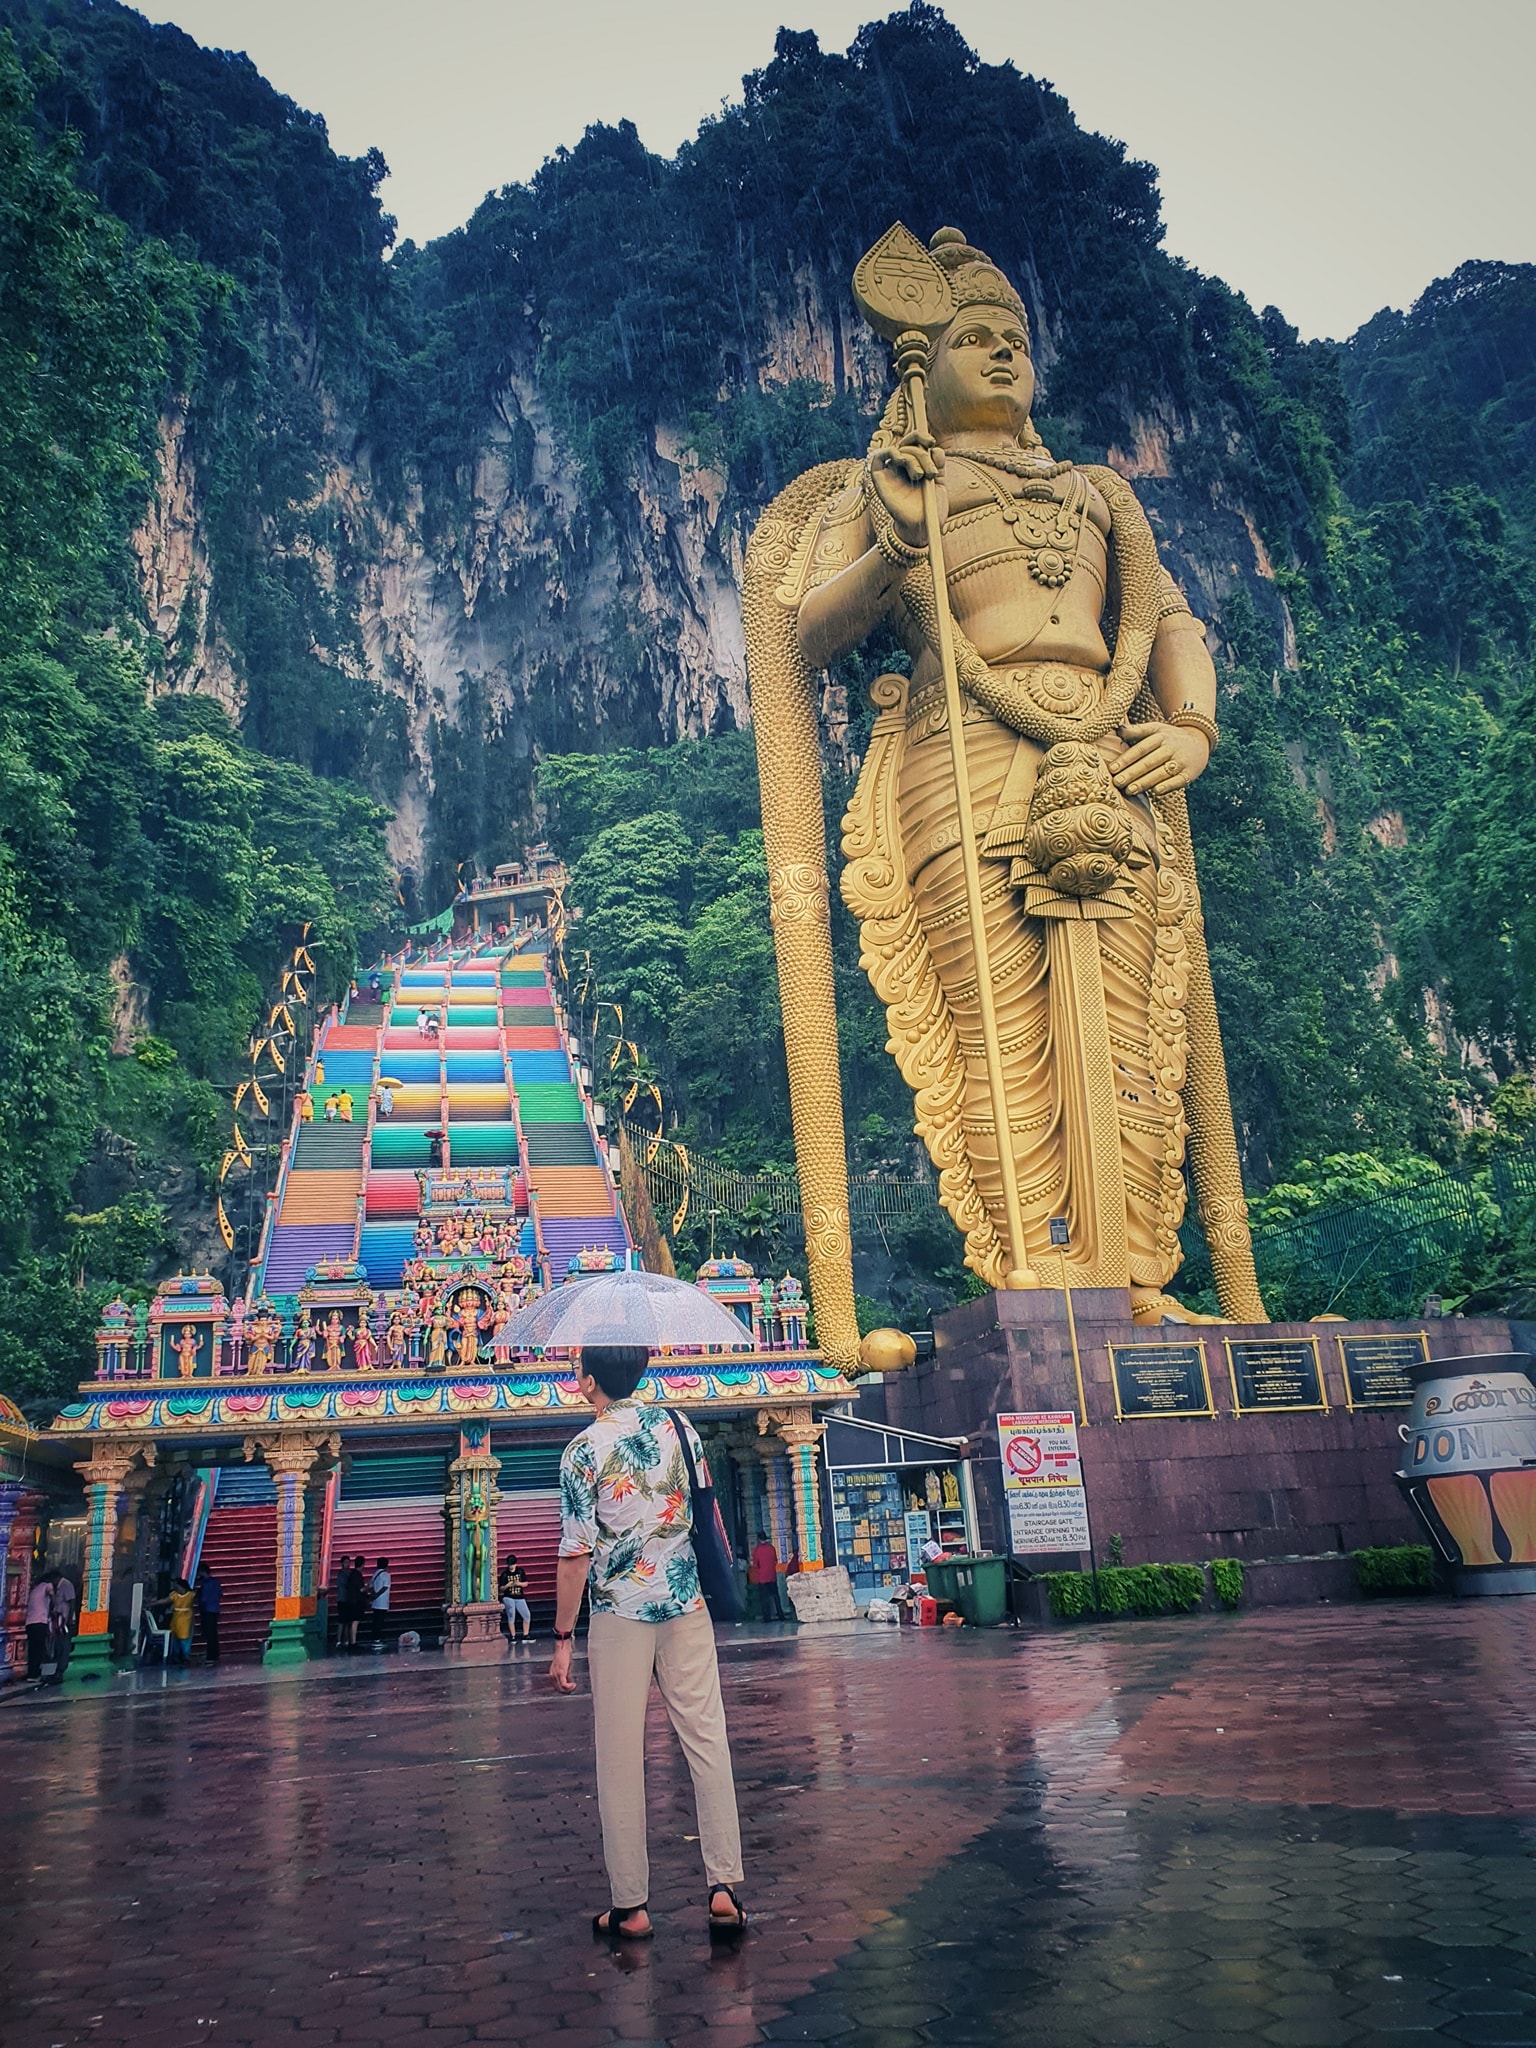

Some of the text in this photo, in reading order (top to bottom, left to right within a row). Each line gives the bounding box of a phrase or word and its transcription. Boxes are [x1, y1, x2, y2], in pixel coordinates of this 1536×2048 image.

[1010, 1441, 1018, 1450] NO
[1017, 1448, 1039, 1468] SMOKING
[1057, 1500, 1070, 1508] 8.30
[1013, 1528, 1044, 1536] ENTRANCE
